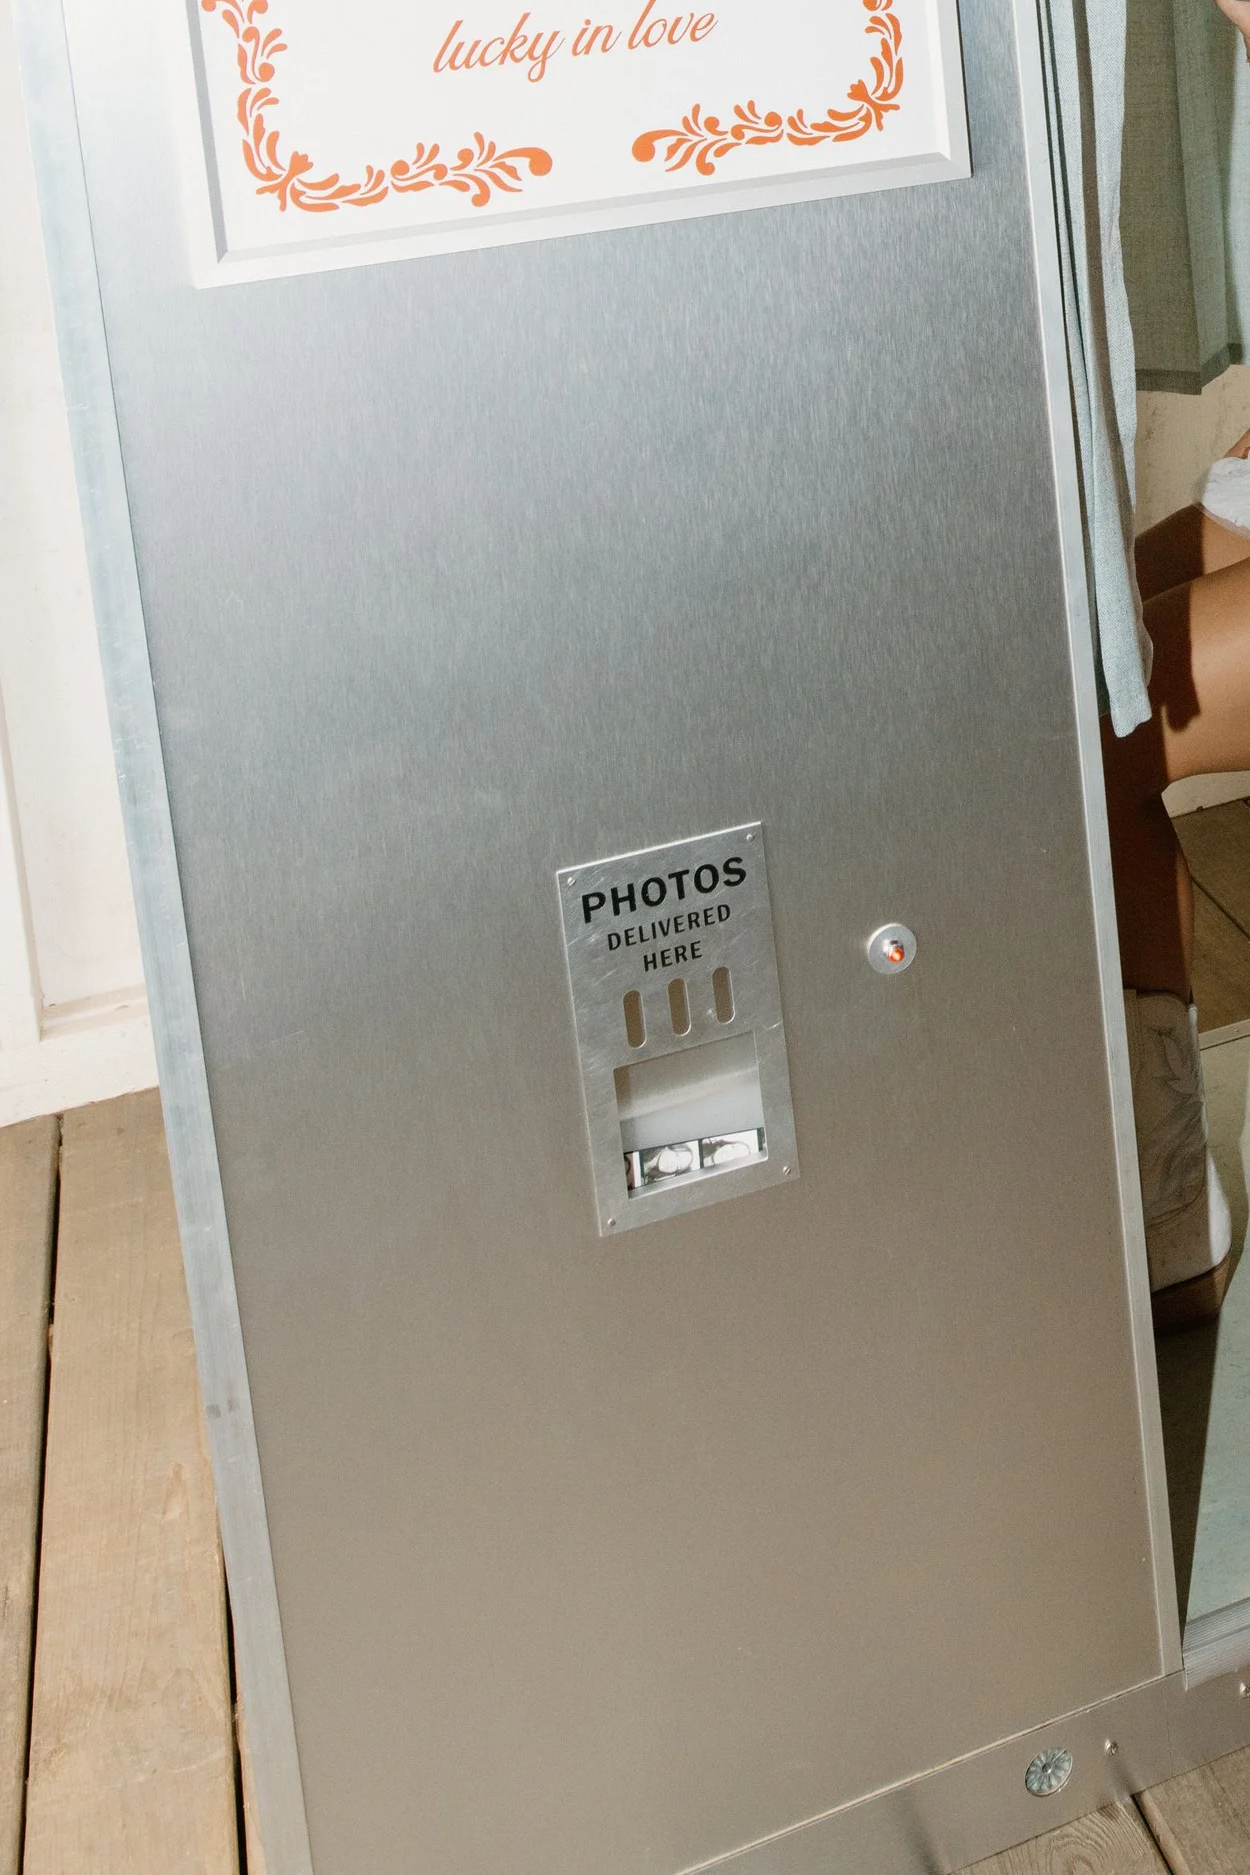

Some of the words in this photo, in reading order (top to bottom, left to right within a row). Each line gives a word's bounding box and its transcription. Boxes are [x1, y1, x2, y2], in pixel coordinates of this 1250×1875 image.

[433, 12, 565, 82] lucky
[571, 19, 622, 57] in
[581, 856, 747, 924] PHOTOS
[607, 903, 731, 951] DELIVERED
[643, 941, 703, 973] HERE
